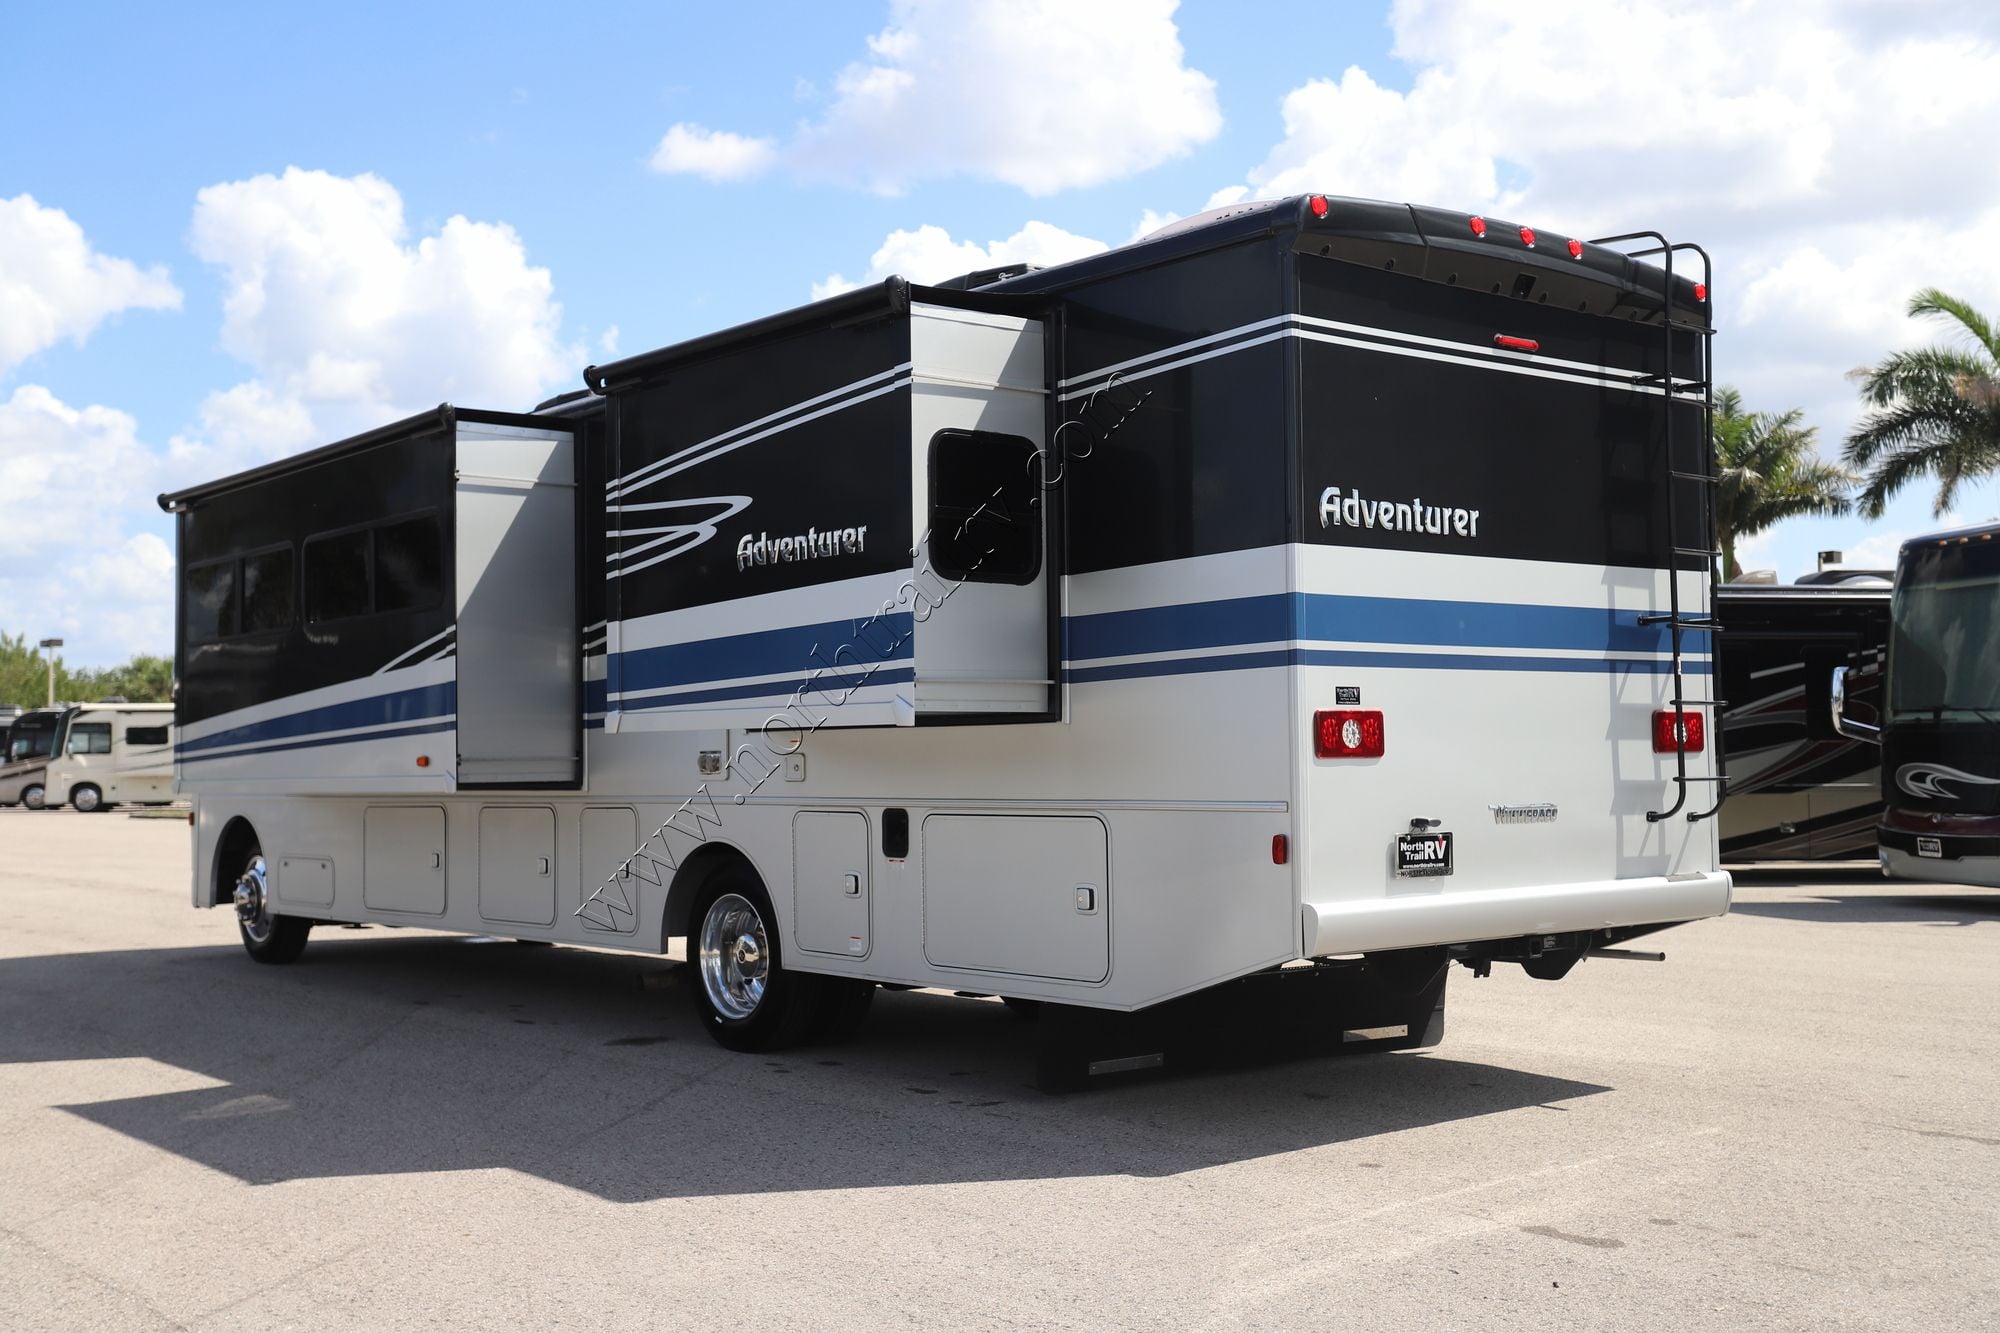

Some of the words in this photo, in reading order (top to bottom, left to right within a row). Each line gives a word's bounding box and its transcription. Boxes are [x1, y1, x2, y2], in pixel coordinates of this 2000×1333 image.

[1319, 486, 1480, 538] Adventurer
[736, 524, 868, 573] Adventurer
[1400, 841, 1424, 852] North
[1424, 840, 1447, 860] RV
[1405, 851, 1424, 861] Trail
